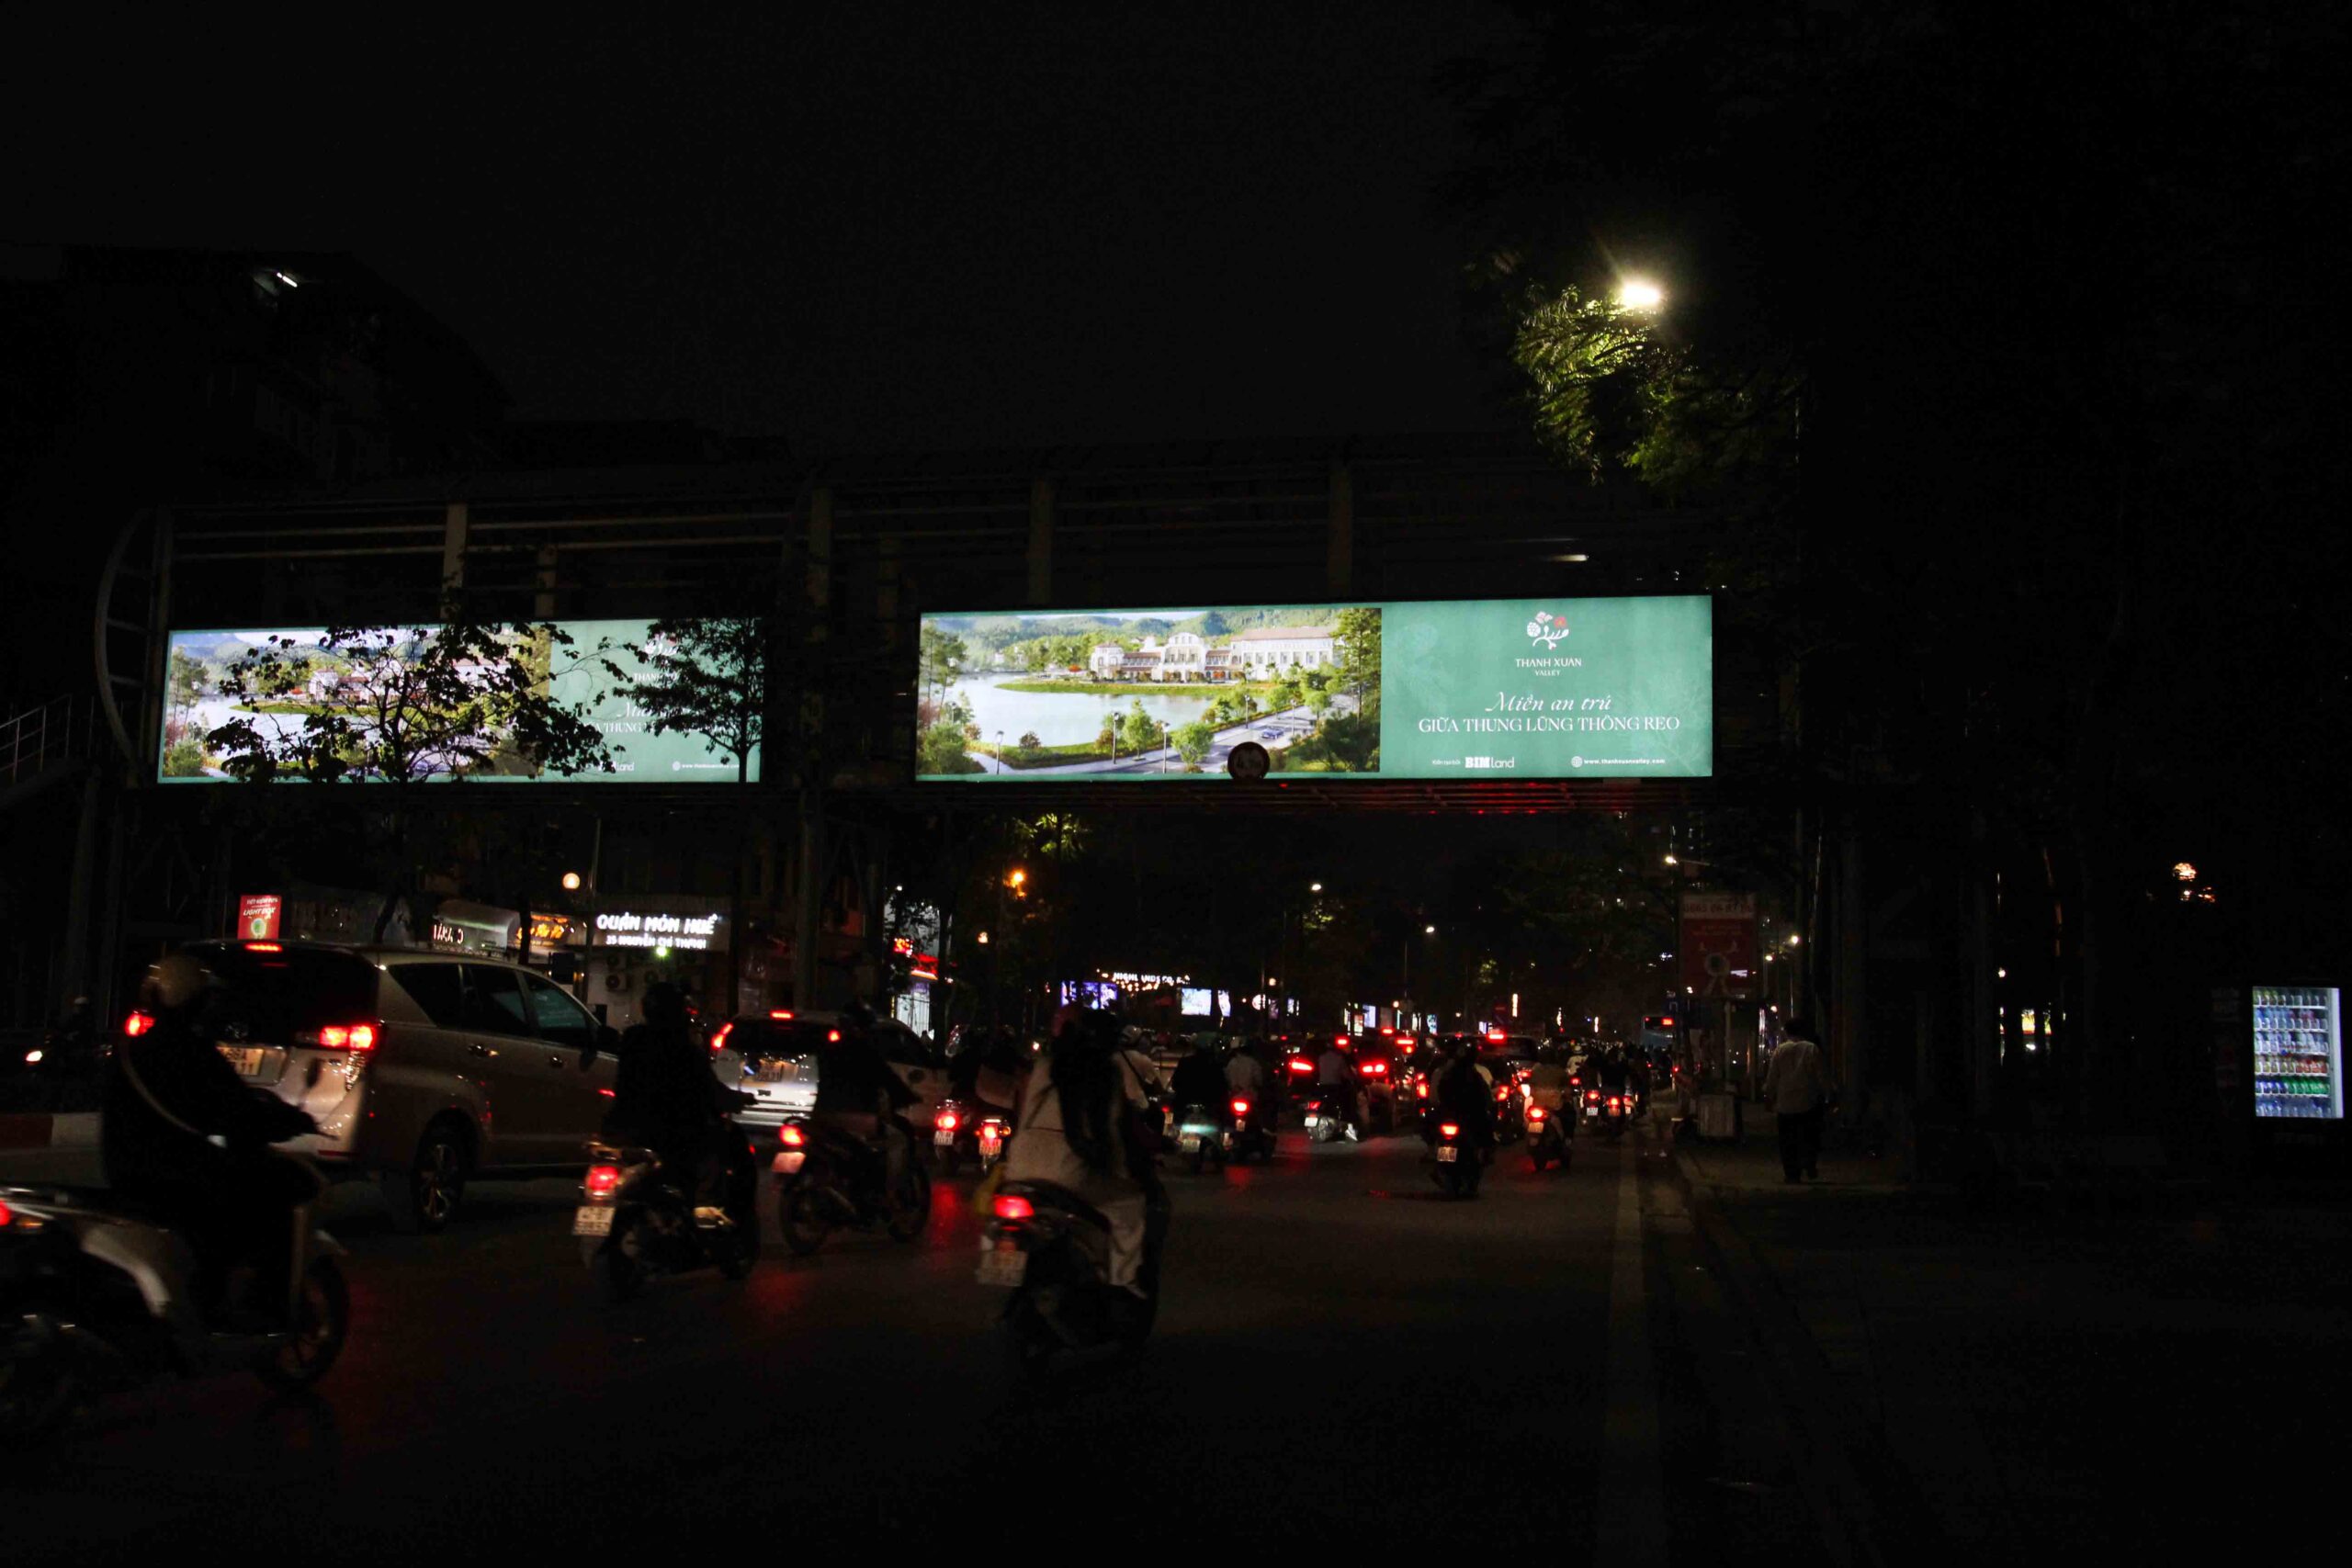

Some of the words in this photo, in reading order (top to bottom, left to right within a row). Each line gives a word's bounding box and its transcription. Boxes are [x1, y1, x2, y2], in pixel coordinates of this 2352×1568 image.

[1515, 658, 1552, 668] THANH
[1554, 657, 1582, 668] XUAN
[1485, 691, 1544, 712] Miền
[1550, 698, 1575, 711] an
[1580, 694, 1612, 711] trú
[1418, 716, 1459, 733] GIỮA
[1463, 717, 1522, 732] THUNG
[1526, 716, 1575, 732] LŨNG
[1577, 714, 1640, 732] THÔNG
[1644, 716, 1680, 731] REO
[596, 911, 641, 931] QUÁN
[644, 913, 681, 932] MÓN
[684, 913, 718, 935] HUẾ
